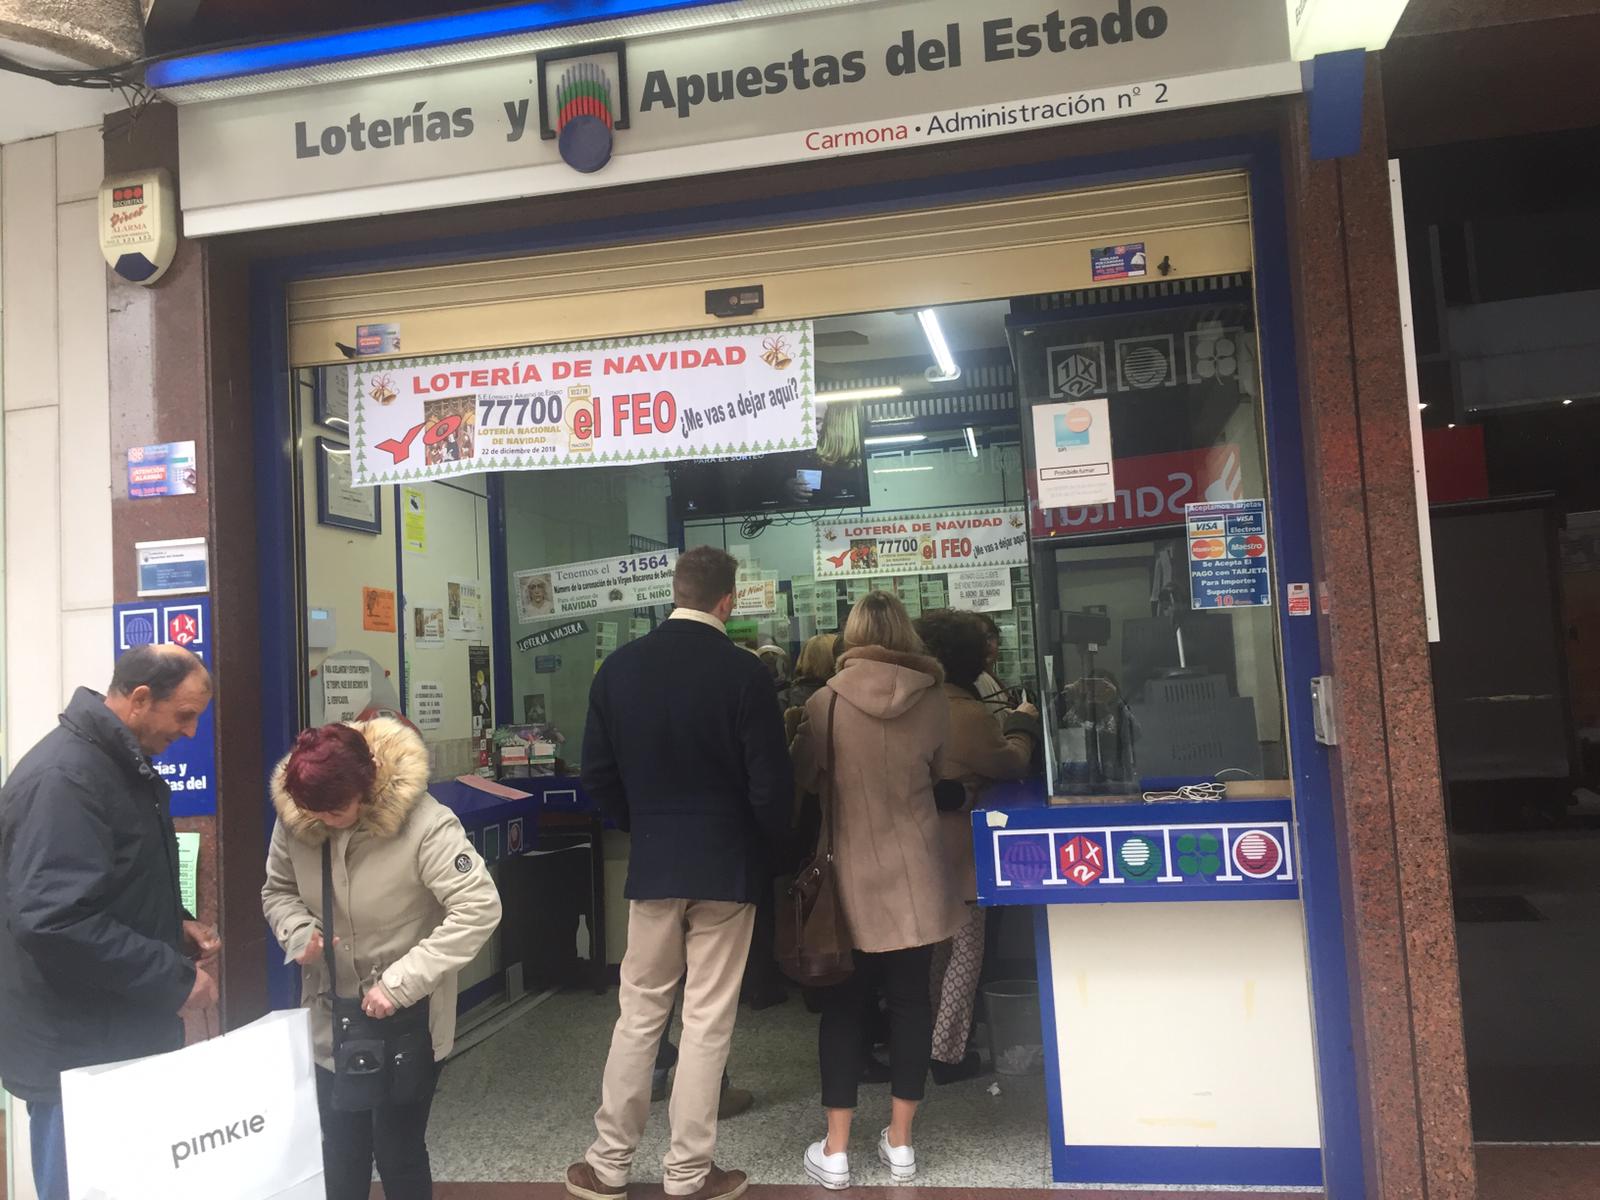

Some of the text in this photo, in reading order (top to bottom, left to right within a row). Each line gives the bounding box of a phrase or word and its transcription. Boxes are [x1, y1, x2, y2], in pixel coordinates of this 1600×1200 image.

[294, 0, 1169, 159] Loterías y Apuestas del Estado
[804, 121, 909, 153] Carmona
[926, 91, 1106, 136] Administración
[1153, 82, 1169, 105] 2
[413, 346, 746, 395] LOTERÍA DE NAVIDAD
[479, 395, 562, 426] 77700
[573, 390, 677, 440] el FEO
[680, 377, 799, 439] ¿Me vas a dejar aquí?
[478, 425, 561, 436] LOTERÍA NACIONAL
[506, 436, 546, 445] NAVIDAD
[500, 446, 530, 455] diciembre
[1188, 501, 1262, 512] Aceptamos Tarjetas
[844, 517, 1003, 537] LOTERÍA DE NAVIDAD
[1196, 522, 1218, 531] VISA
[878, 538, 918, 554] 77700
[923, 537, 972, 560] el FEO
[1231, 543, 1263, 551] Maestro
[556, 554, 669, 582] Tenemos el 31564
[1232, 567, 1267, 575] TARJETA
[571, 583, 577, 592] de
[606, 579, 612, 587] de
[618, 576, 632, 586] Virgen
[1221, 578, 1256, 586] Importes
[636, 588, 671, 601] EL NIÑO
[1206, 588, 1248, 596] Superiores
[561, 600, 598, 612] NAVIDAD
[1215, 594, 1233, 608] 10
[179, 763, 187, 777] y
[186, 775, 206, 790] del
[171, 1114, 265, 1169] pimkie
